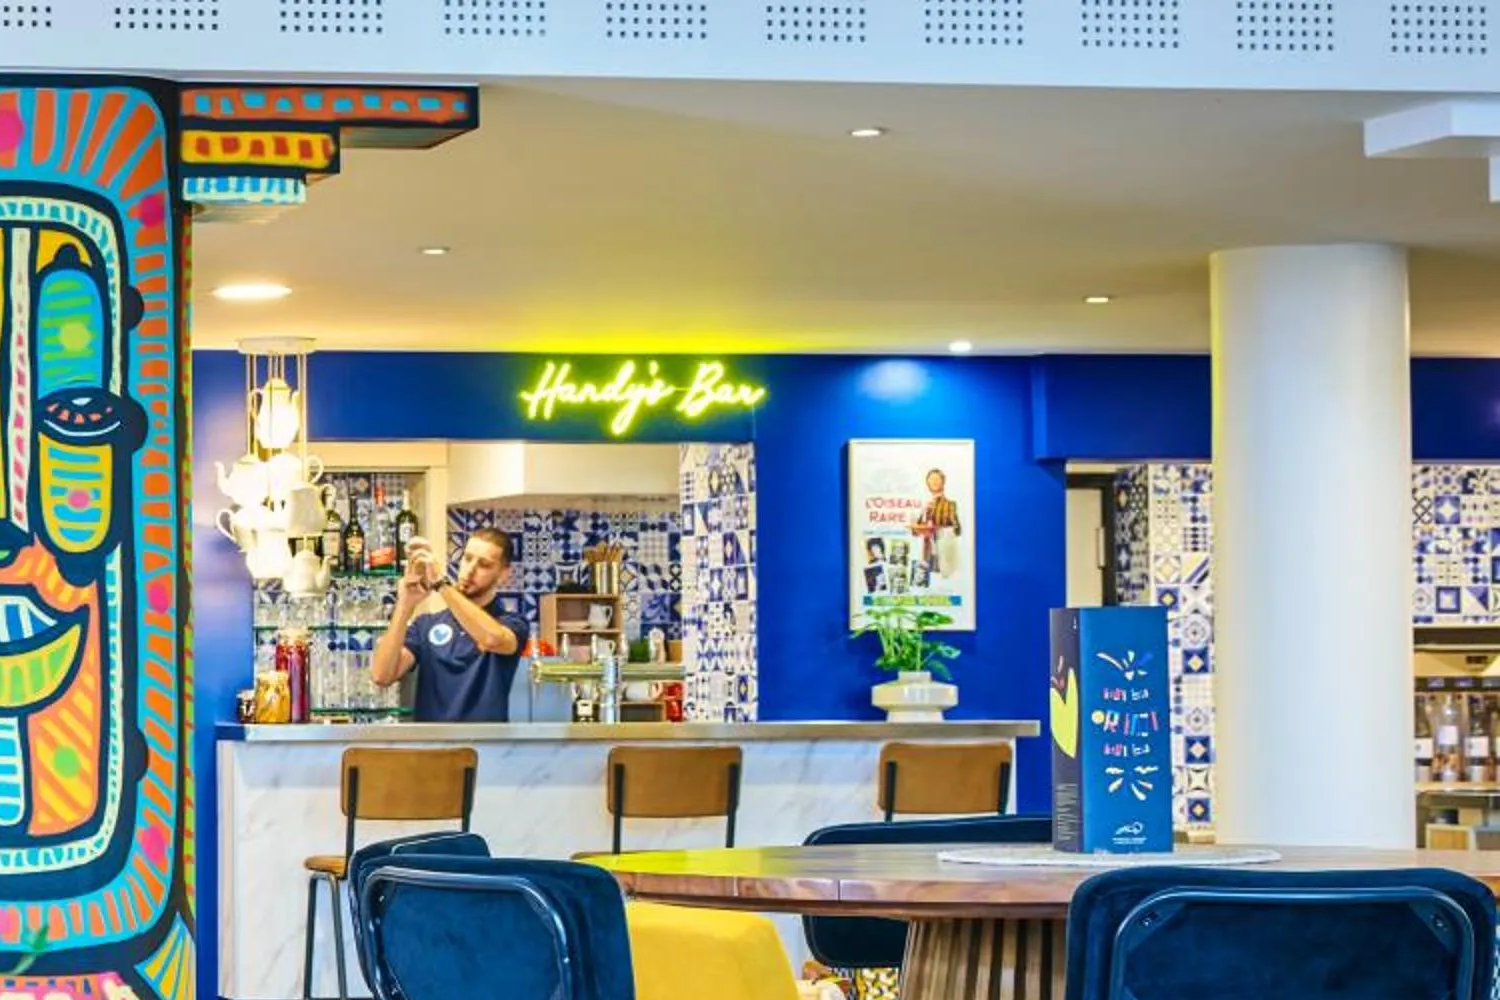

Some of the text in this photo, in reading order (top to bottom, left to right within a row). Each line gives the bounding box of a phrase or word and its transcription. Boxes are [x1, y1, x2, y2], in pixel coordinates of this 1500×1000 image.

[517, 360, 767, 436] Handy's Bar
[869, 511, 907, 522] RARE
